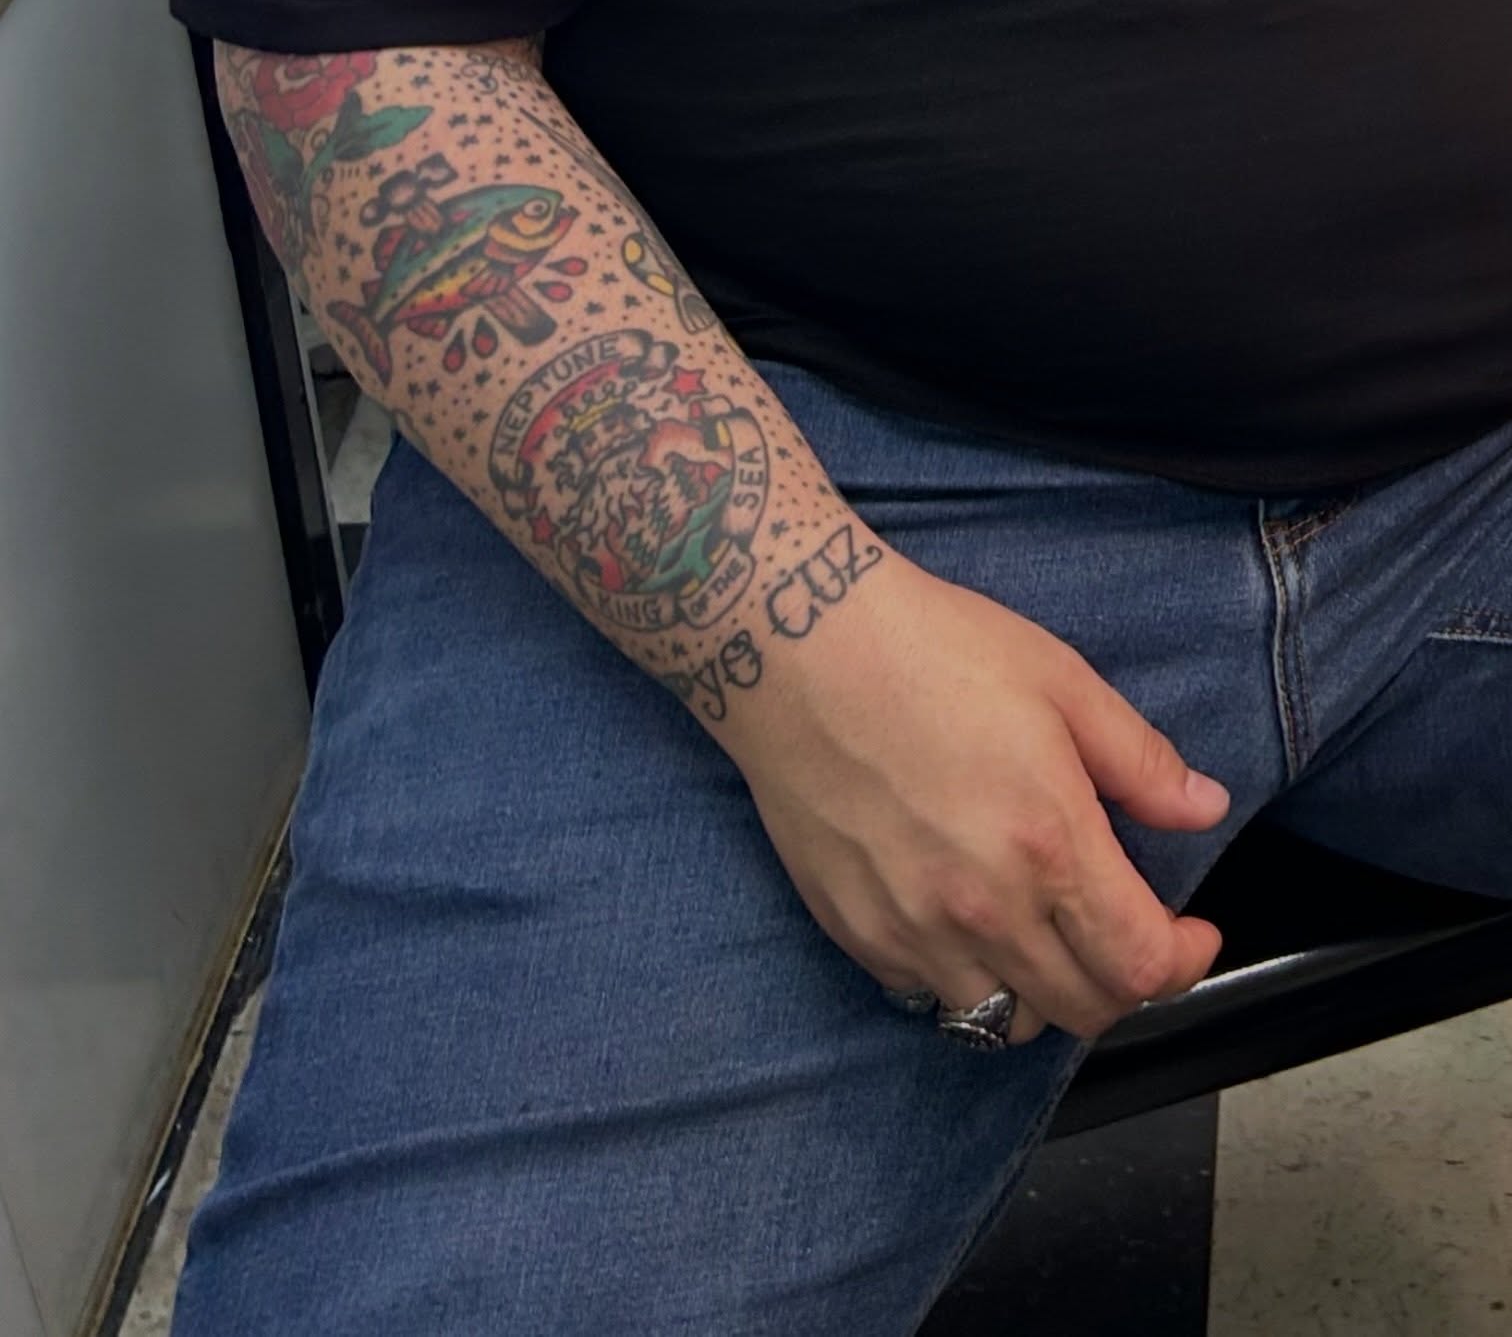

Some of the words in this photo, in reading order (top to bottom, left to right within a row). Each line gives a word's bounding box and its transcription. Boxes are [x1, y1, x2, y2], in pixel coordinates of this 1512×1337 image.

[494, 334, 622, 458] NEPTUNE
[732, 444, 765, 511] SEA
[688, 593, 709, 617] OF
[708, 557, 747, 594] THE
[765, 523, 884, 640] CUZ
